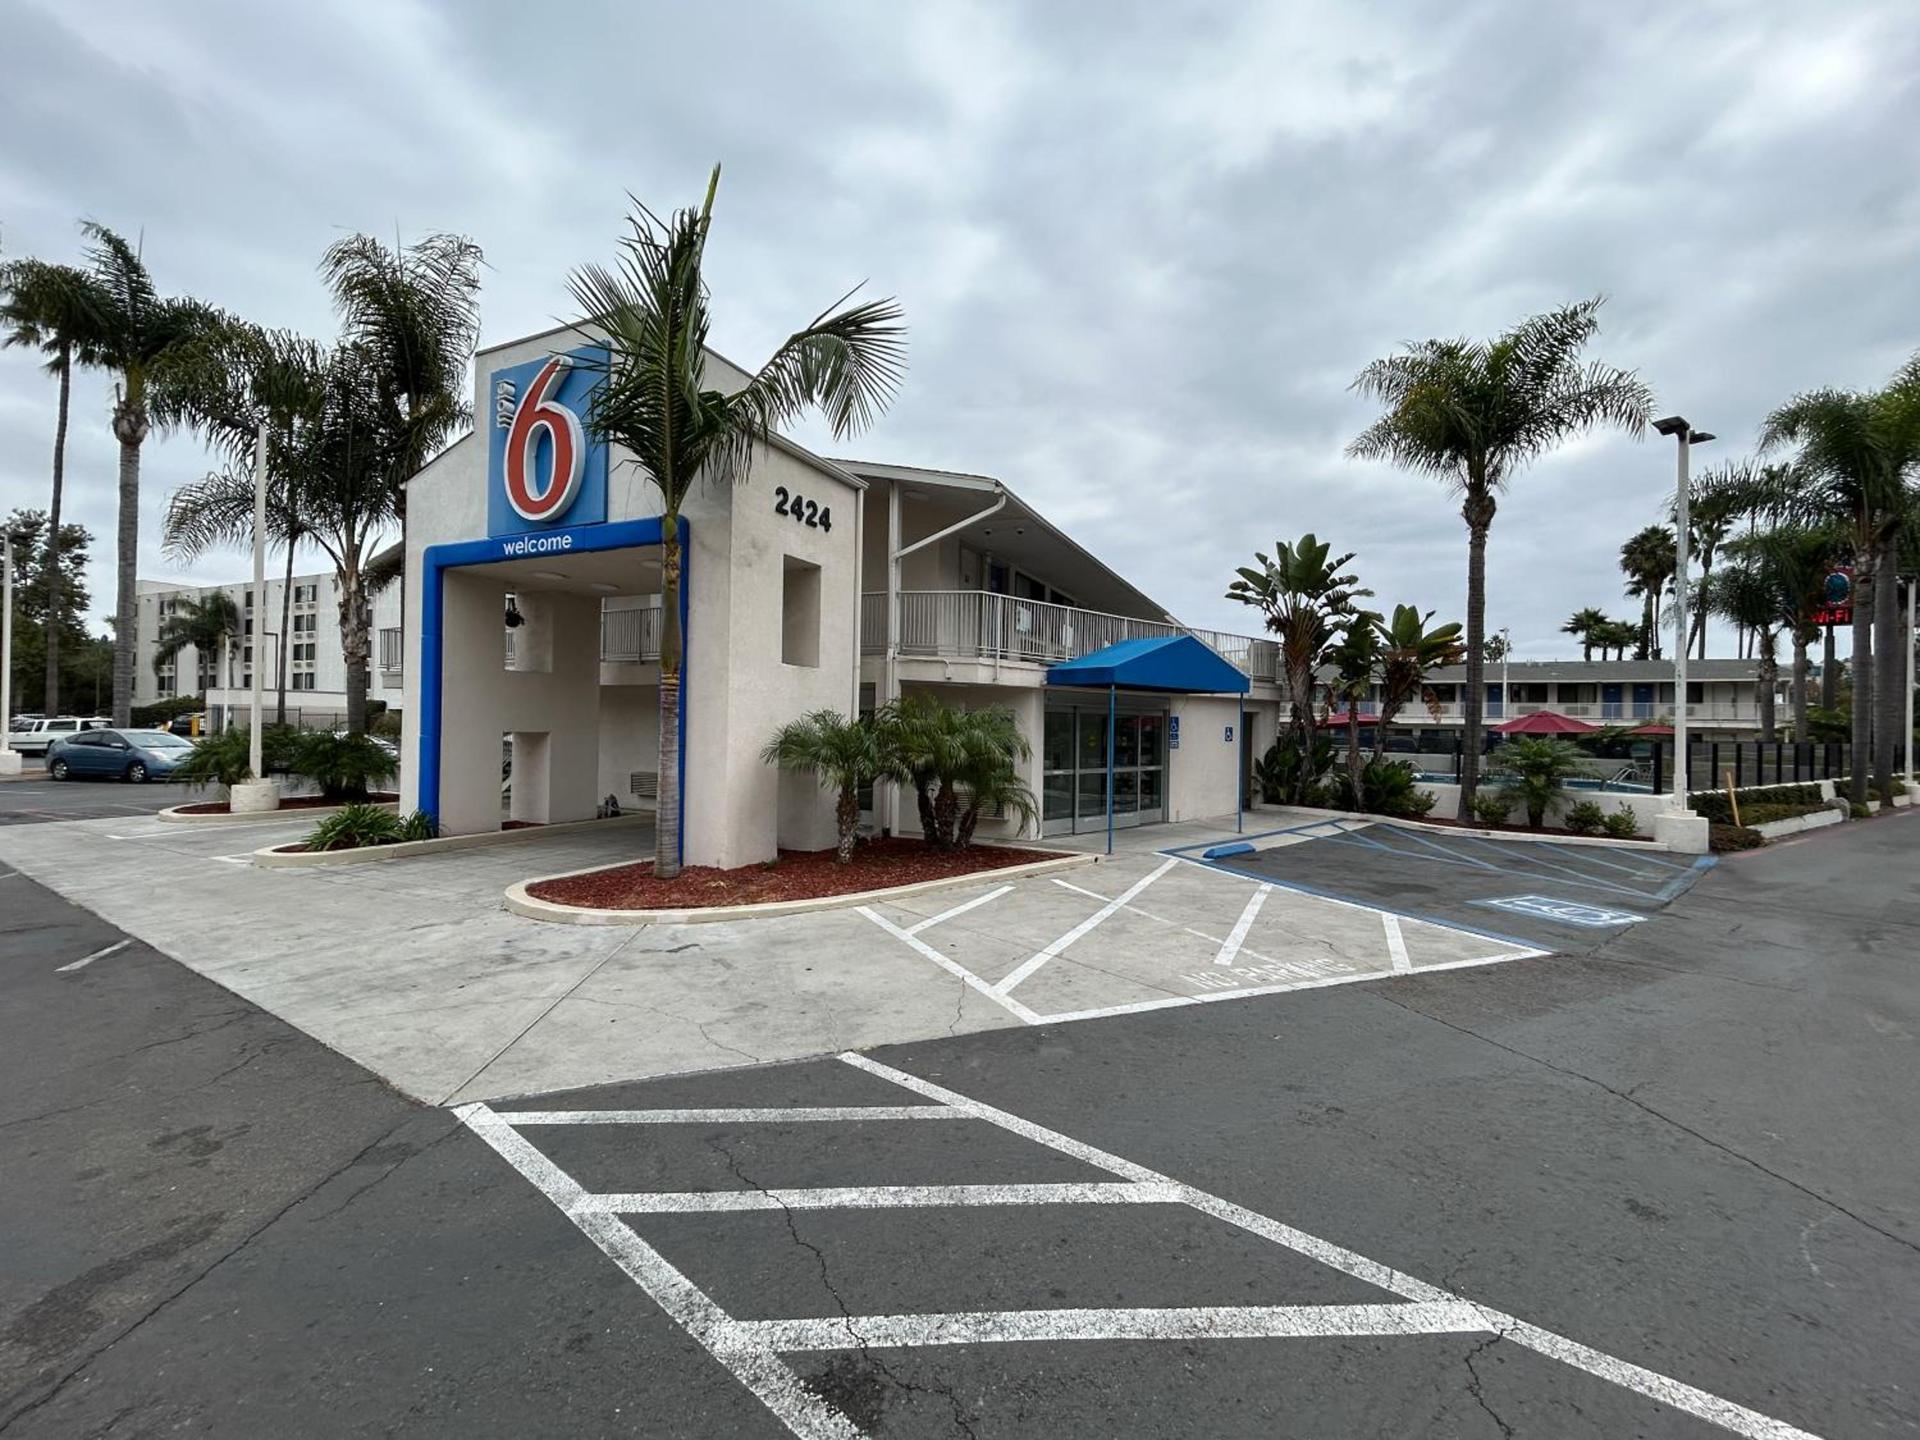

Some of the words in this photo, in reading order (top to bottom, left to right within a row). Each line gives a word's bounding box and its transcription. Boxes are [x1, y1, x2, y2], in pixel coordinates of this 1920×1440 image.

[505, 355, 585, 521] 6
[775, 486, 831, 533] 2424
[503, 535, 572, 555] welcome
[1178, 972, 1239, 989] NO
[1230, 960, 1356, 983] PARKING
